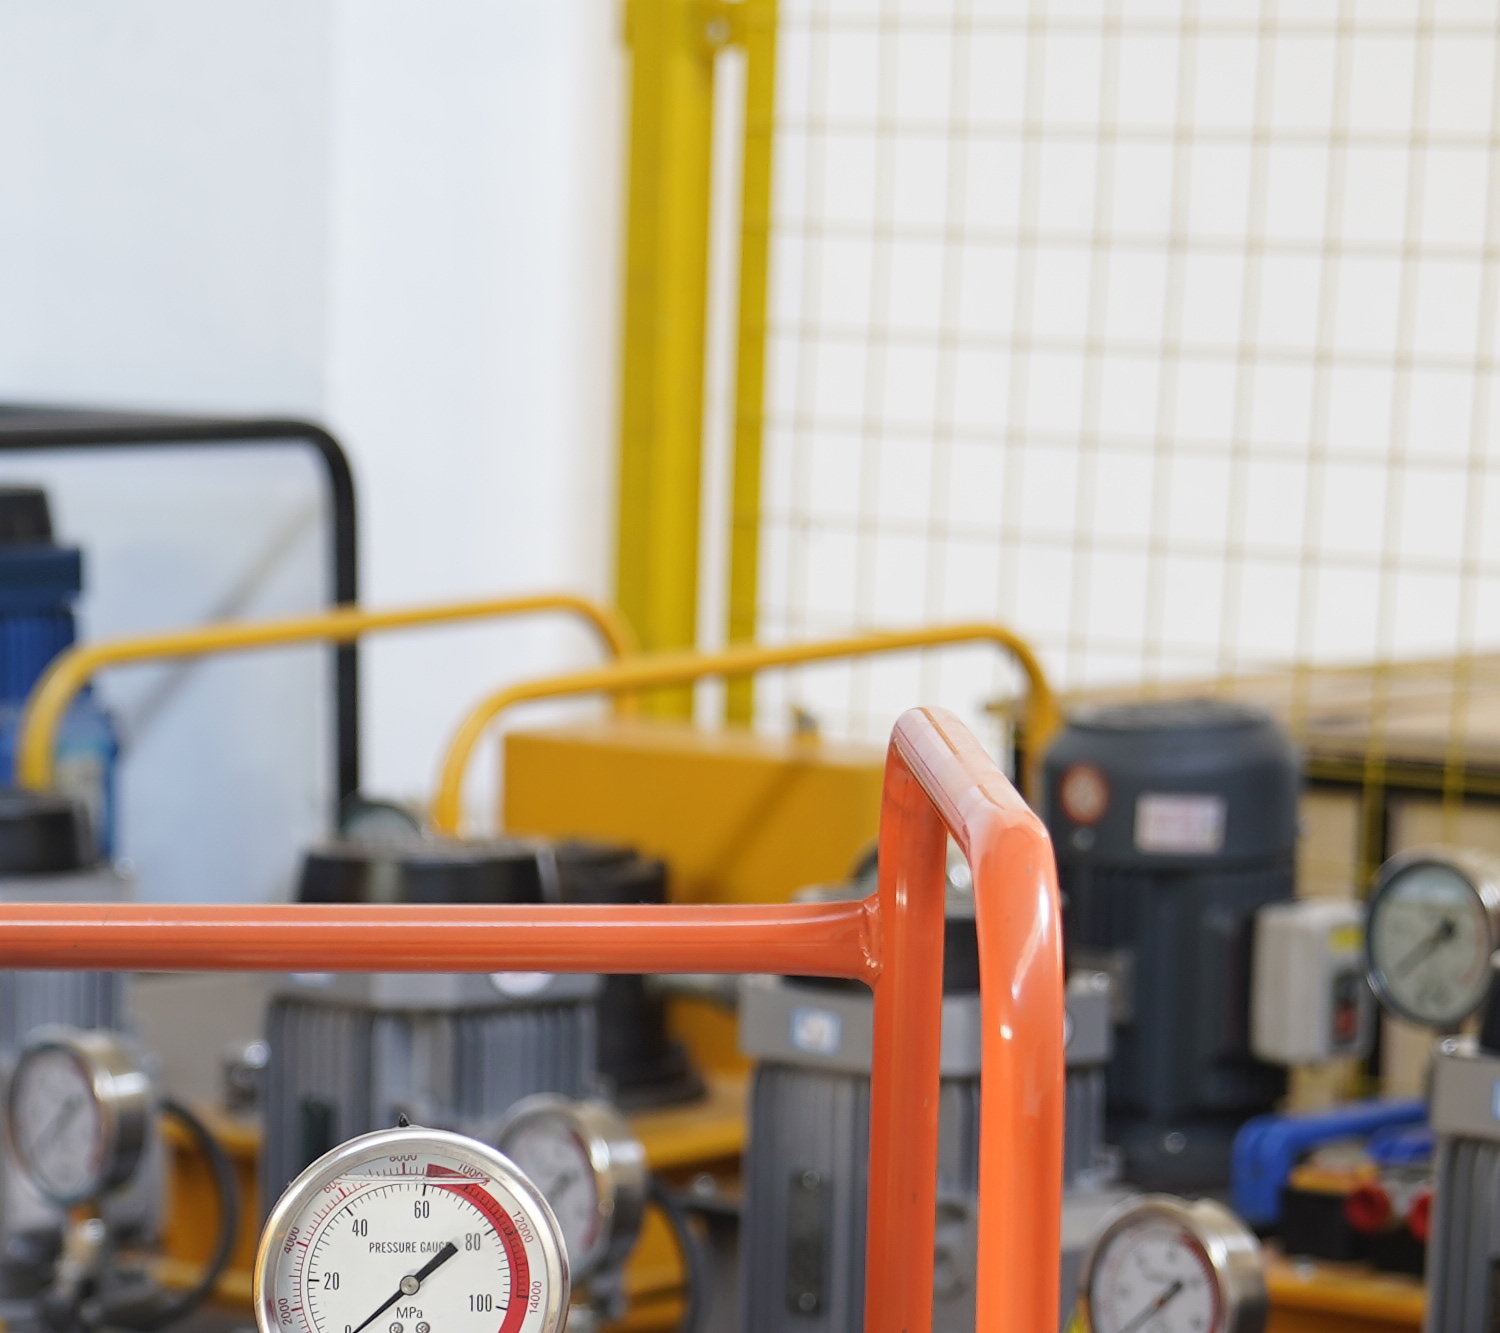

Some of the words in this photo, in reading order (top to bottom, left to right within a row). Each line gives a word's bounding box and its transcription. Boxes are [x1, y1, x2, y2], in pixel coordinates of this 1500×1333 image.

[414, 1200, 430, 1219] 60
[352, 1219, 368, 1237] 40
[512, 1210, 534, 1244] 12000
[369, 1241, 417, 1254] PRESSURE
[420, 1241, 453, 1253] GAUG
[465, 1233, 481, 1251] 80
[323, 1272, 340, 1291] 20
[469, 1293, 492, 1312] 100
[529, 1280, 543, 1314] 14000
[278, 1297, 293, 1326] 2000
[396, 1307, 424, 1319] MPa
